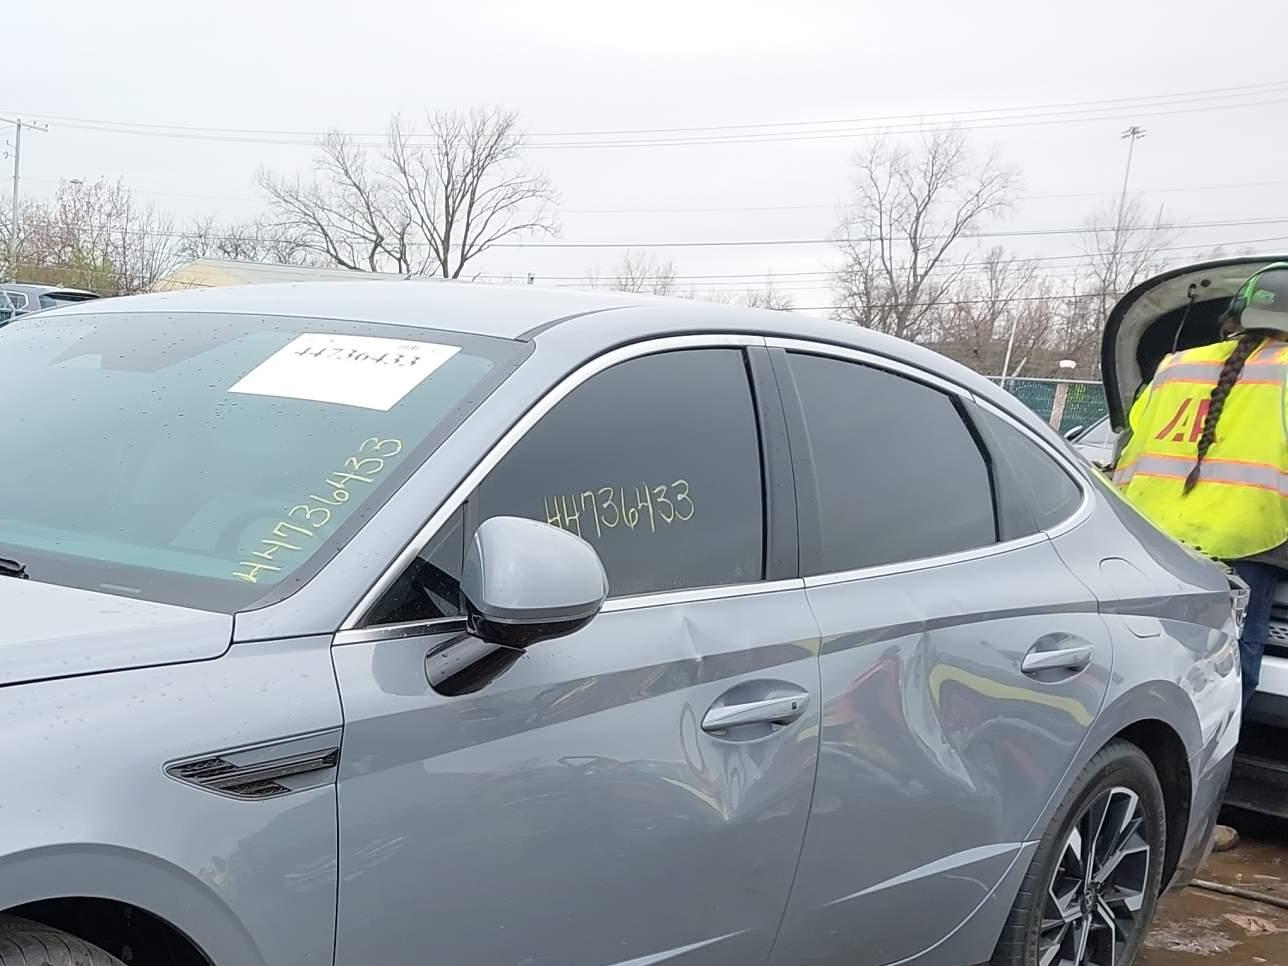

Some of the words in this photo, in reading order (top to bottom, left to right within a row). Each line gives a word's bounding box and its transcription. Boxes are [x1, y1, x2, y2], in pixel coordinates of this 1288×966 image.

[295, 347, 421, 366] 44736433
[232, 437, 402, 584] 44736433
[544, 479, 695, 538] 44736433
